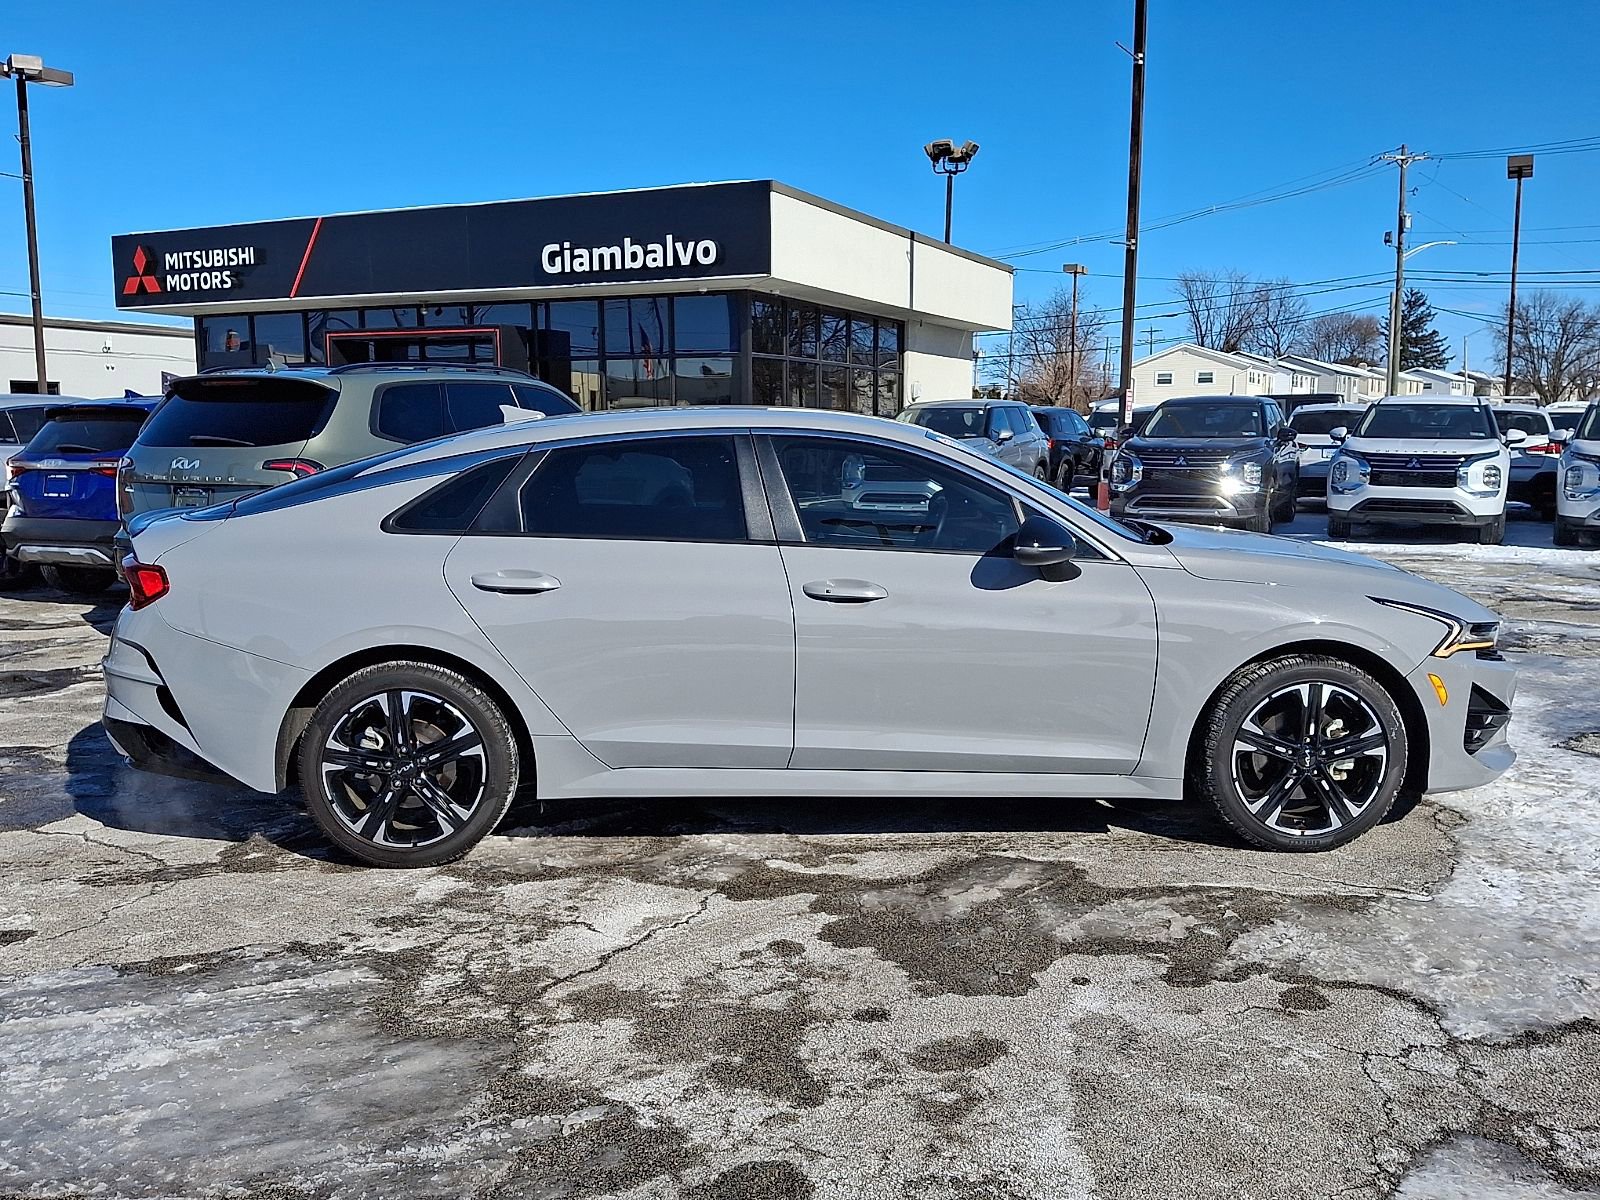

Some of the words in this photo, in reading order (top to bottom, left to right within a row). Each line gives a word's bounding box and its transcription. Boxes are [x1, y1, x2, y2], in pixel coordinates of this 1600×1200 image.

[165, 246, 255, 270] MITSUBISHI
[541, 234, 717, 274] Giambalvo
[166, 270, 232, 292] MOTORS
